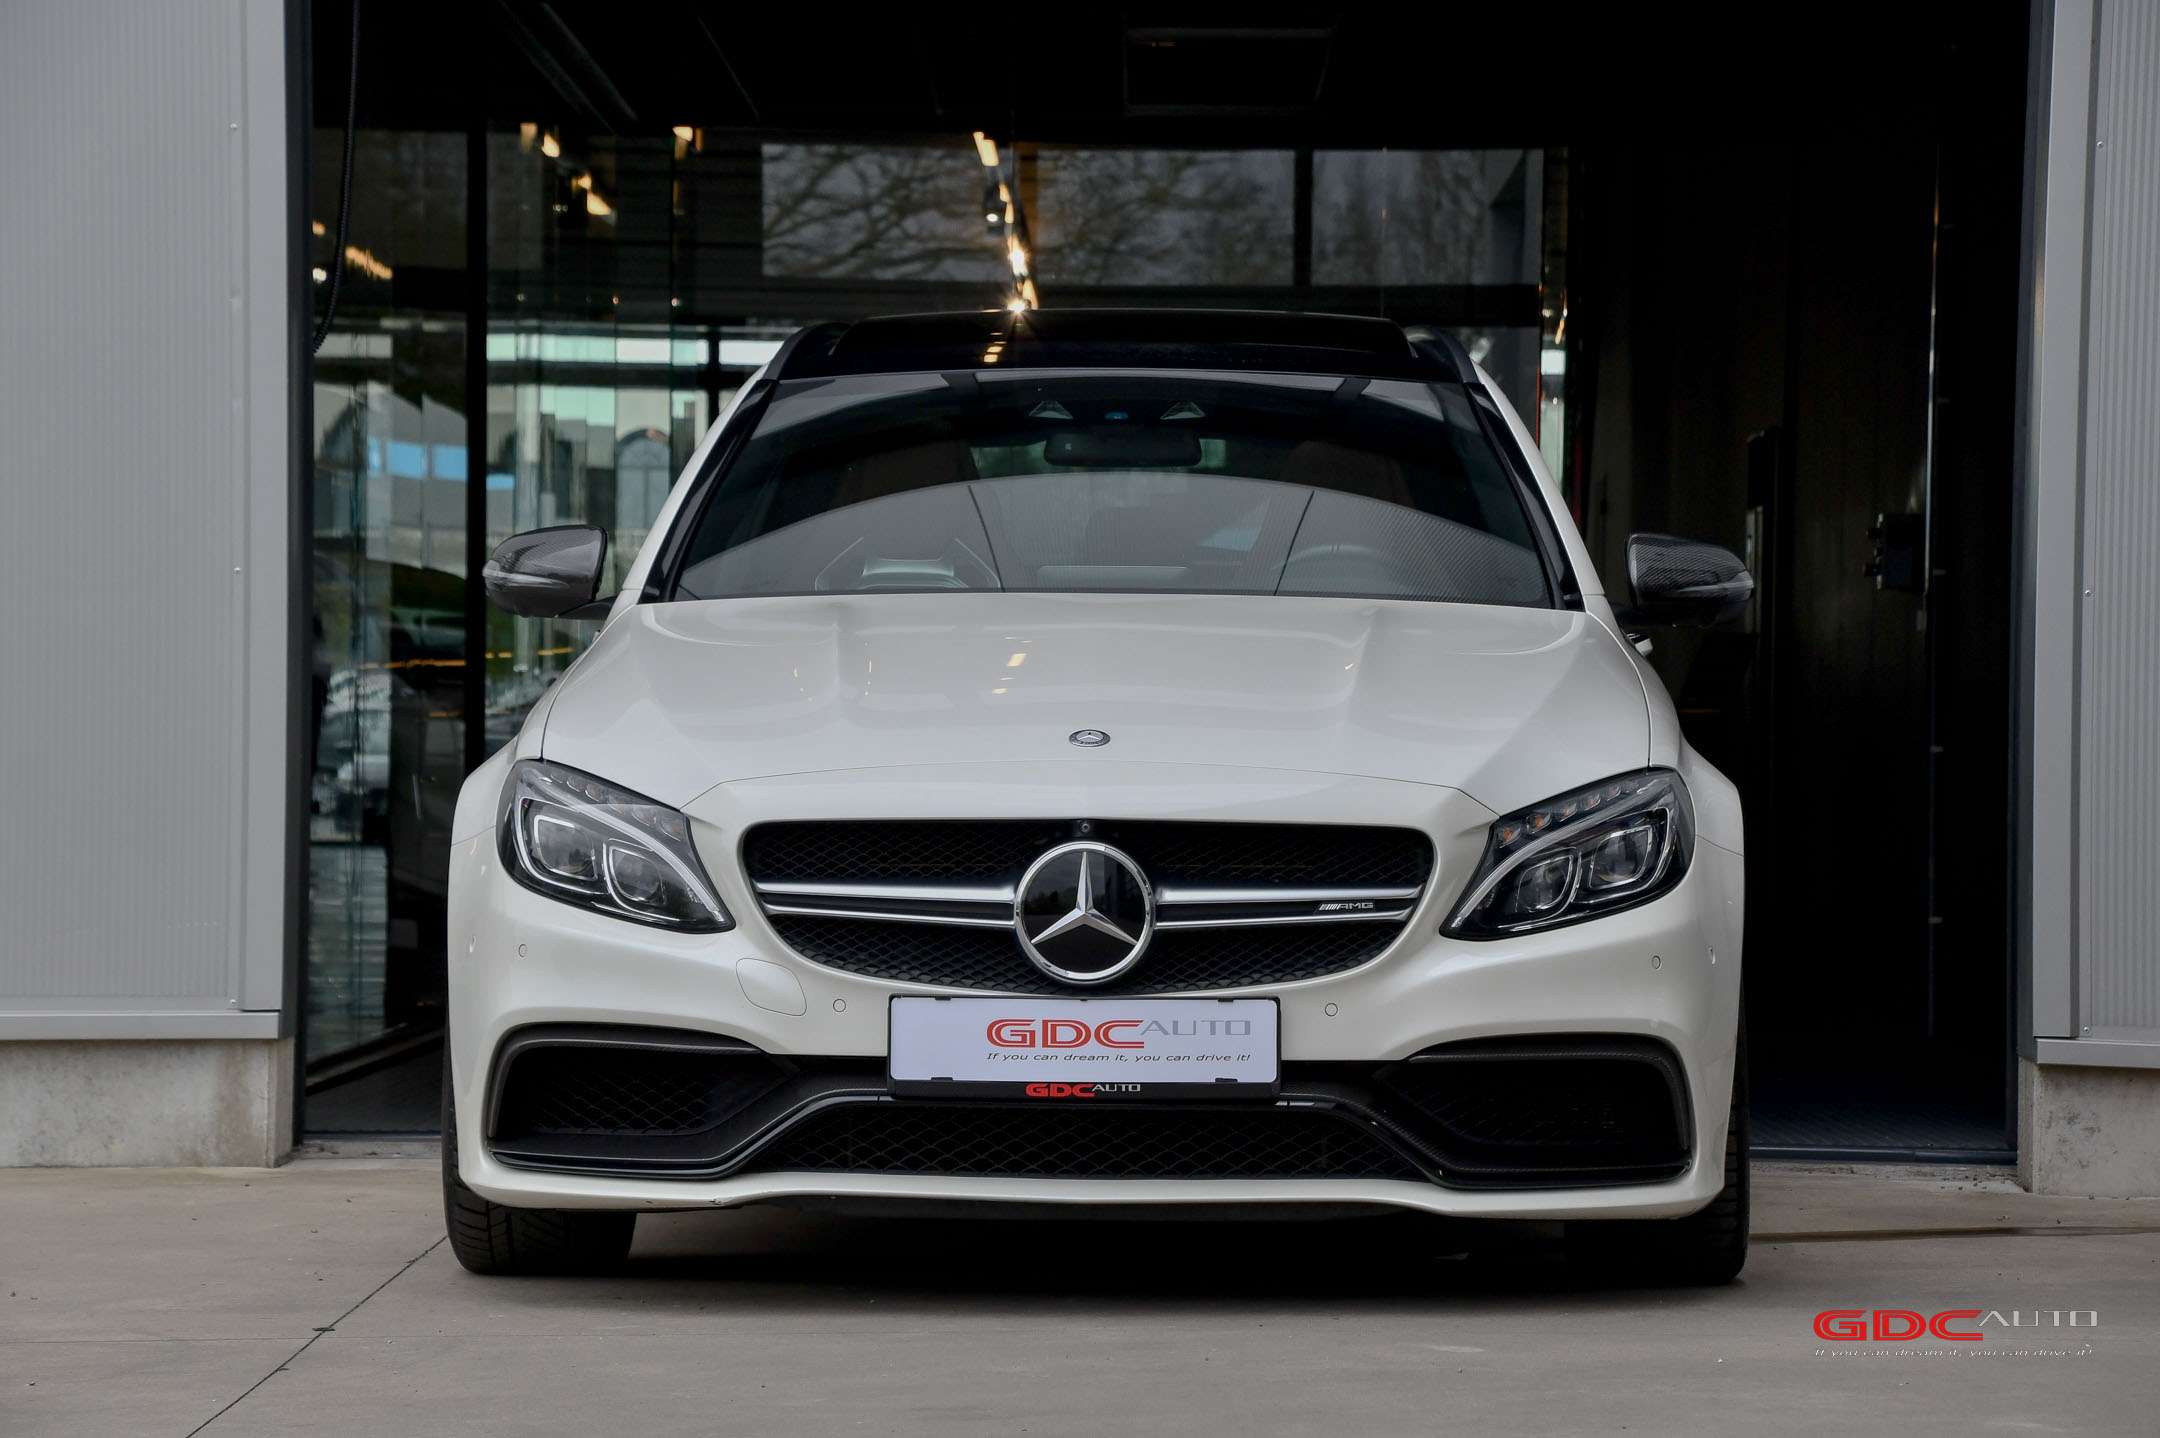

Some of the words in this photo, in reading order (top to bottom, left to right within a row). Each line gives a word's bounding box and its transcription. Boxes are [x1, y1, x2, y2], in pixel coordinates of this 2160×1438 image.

[1338, 902, 1374, 911] AMG
[986, 1018, 1145, 1049] GDC
[1140, 1019, 1251, 1036] AUTO
[986, 1052, 1000, 1061] If
[1003, 1053, 1029, 1063] you
[1063, 1053, 1110, 1061] dream
[1115, 1054, 1129, 1063] it,
[1135, 1055, 1161, 1063] you
[1195, 1053, 1232, 1062] drive
[1237, 1053, 1251, 1062] it!
[1026, 1083, 1095, 1097] GDC
[1092, 1084, 1141, 1092] AUTO
